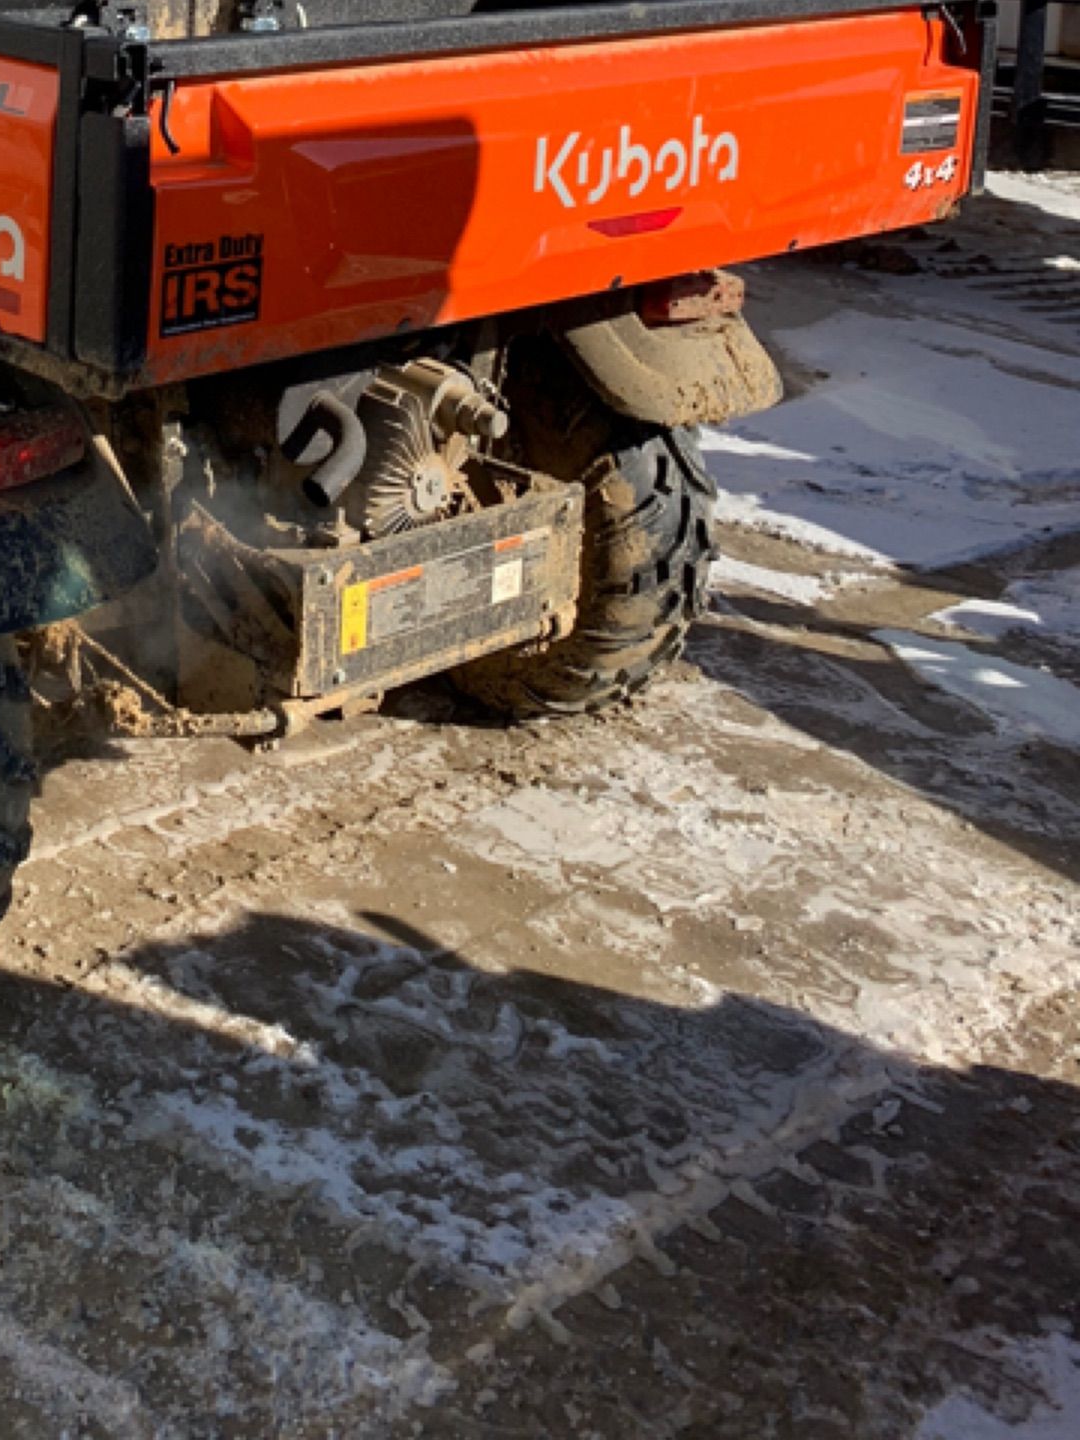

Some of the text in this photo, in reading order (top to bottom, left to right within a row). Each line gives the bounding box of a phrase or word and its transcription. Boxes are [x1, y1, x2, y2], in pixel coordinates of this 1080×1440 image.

[533, 115, 740, 209] Kubota
[164, 233, 265, 268] Extra Duty
[165, 263, 259, 321] IRS
